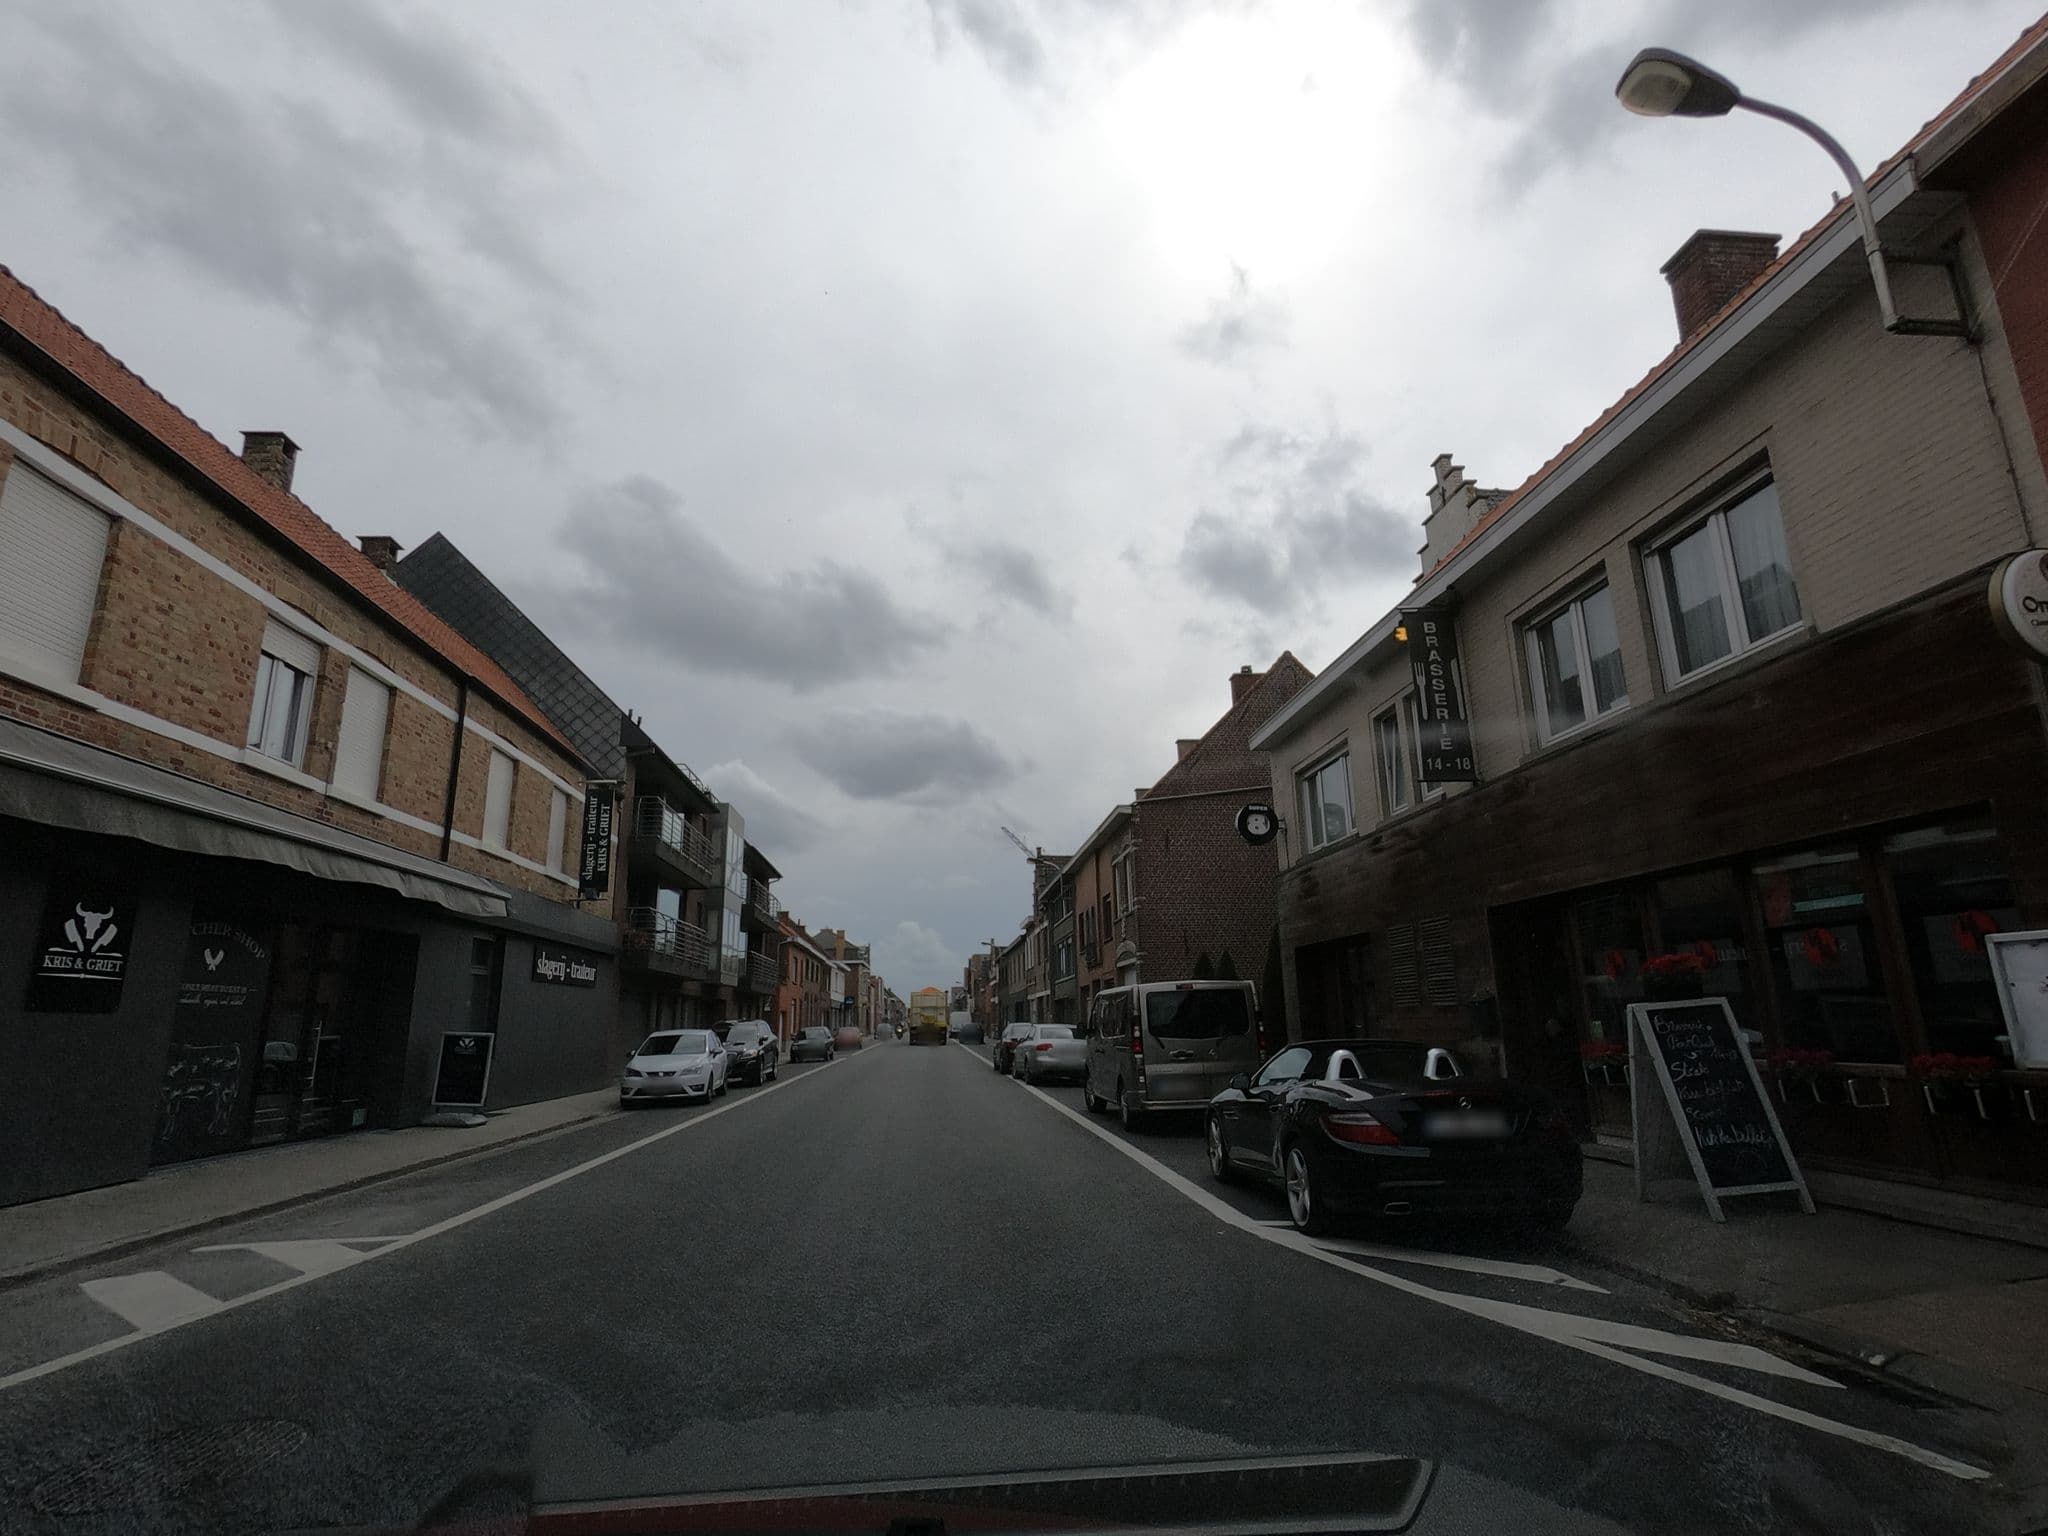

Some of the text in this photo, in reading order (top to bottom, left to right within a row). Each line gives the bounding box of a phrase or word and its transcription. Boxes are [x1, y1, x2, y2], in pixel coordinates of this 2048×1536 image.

[1423, 621, 1453, 750] BRASSERIE
[1426, 757, 1442, 770] 14
[1455, 756, 1471, 770] 18
[585, 796, 598, 834] traiteur
[597, 803, 611, 872] KRIS & GRIET
[582, 843, 597, 880] slagerij
[42, 955, 124, 973] KRIS & GRIET
[536, 952, 566, 982] slagerij
[571, 959, 597, 981] traiteur
